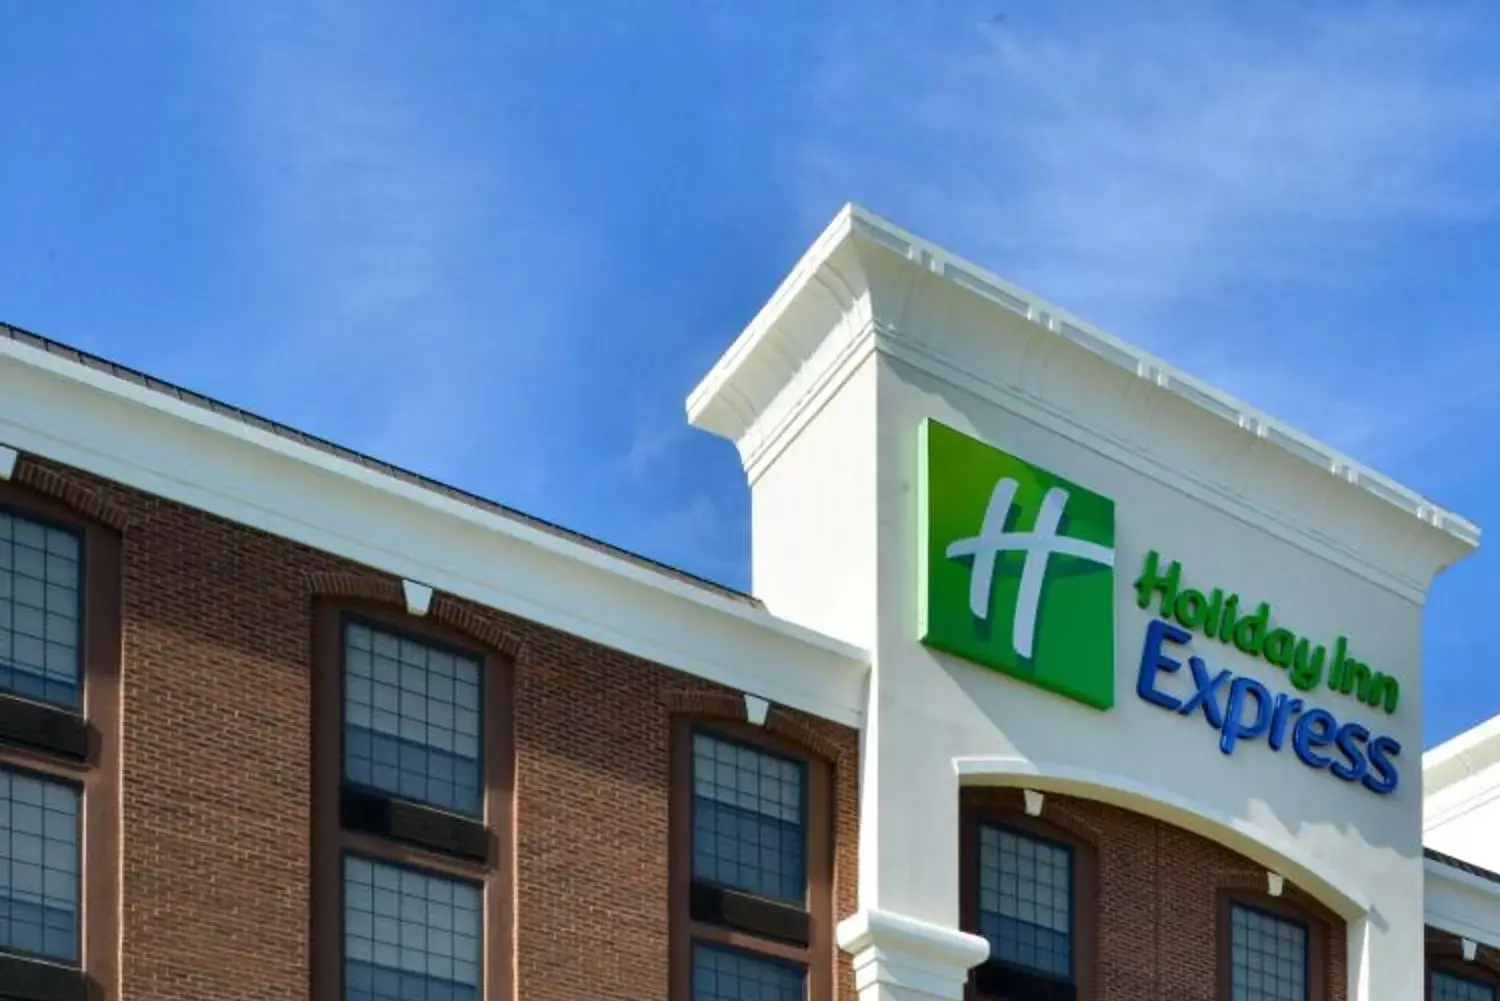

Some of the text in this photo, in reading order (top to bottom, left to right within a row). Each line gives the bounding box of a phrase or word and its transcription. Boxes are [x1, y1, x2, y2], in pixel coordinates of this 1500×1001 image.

[946, 477, 1114, 658] H
[1134, 549, 1399, 715] Holiday Inn
[1136, 619, 1401, 794] Express
